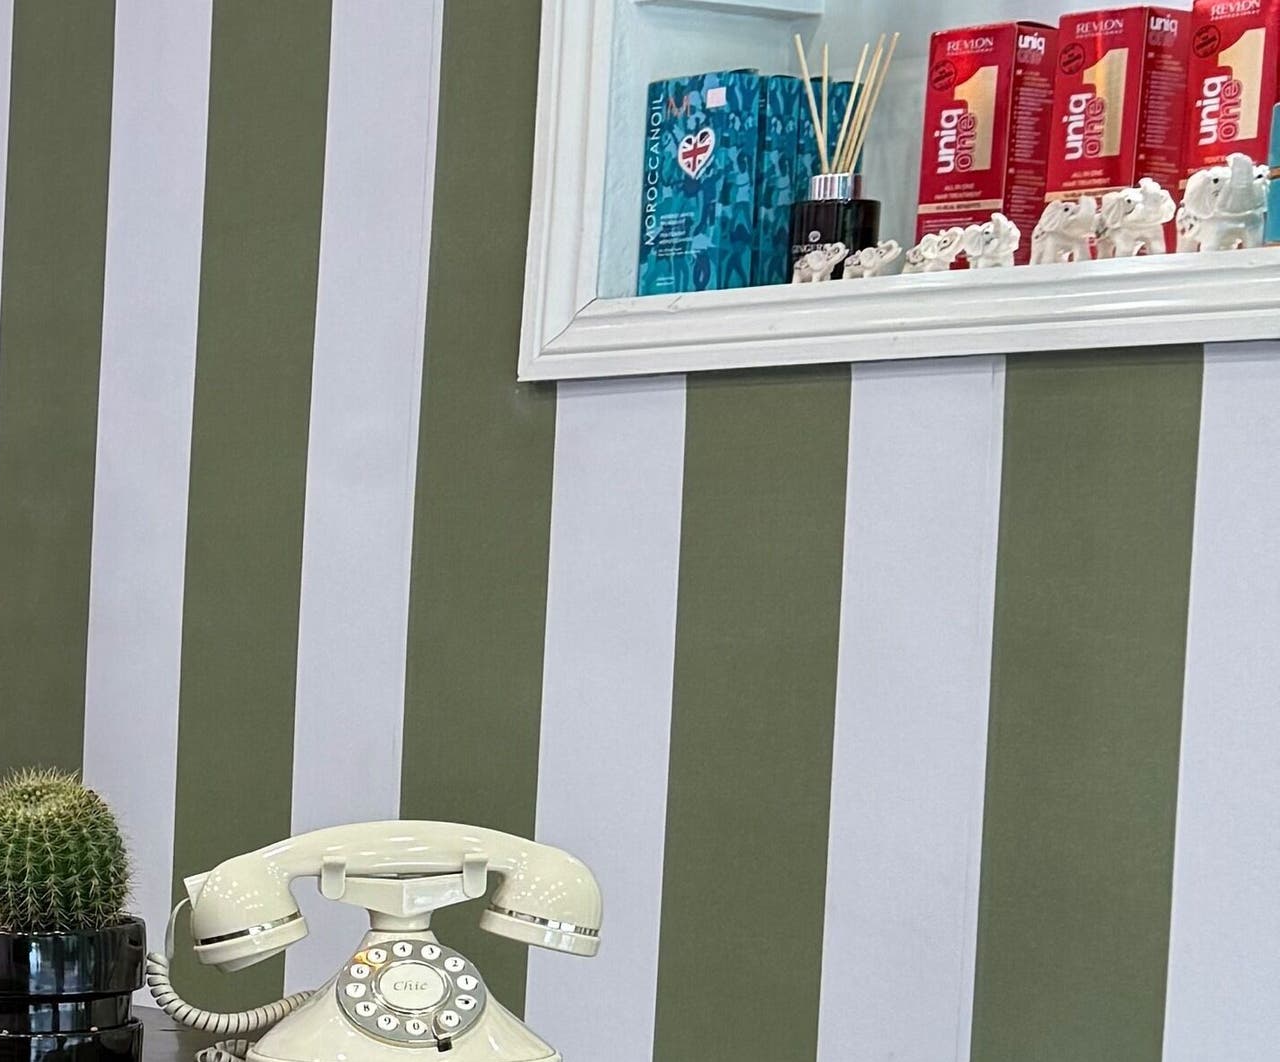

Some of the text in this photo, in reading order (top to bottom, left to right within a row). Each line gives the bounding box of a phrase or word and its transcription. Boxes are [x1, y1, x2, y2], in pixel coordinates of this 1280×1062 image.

[947, 37, 994, 51] REVLON
[1018, 32, 1046, 55] uniq
[1076, 19, 1124, 34] REVLON
[1150, 14, 1178, 37] uniq
[1062, 92, 1093, 160] uniq
[1084, 97, 1105, 158] one
[1195, 75, 1228, 146] uniq
[1218, 80, 1241, 142] one
[644, 93, 664, 246] MOROCCANOIL
[934, 108, 965, 174] uniq
[954, 113, 977, 173] one
[393, 981, 429, 991] Chic
